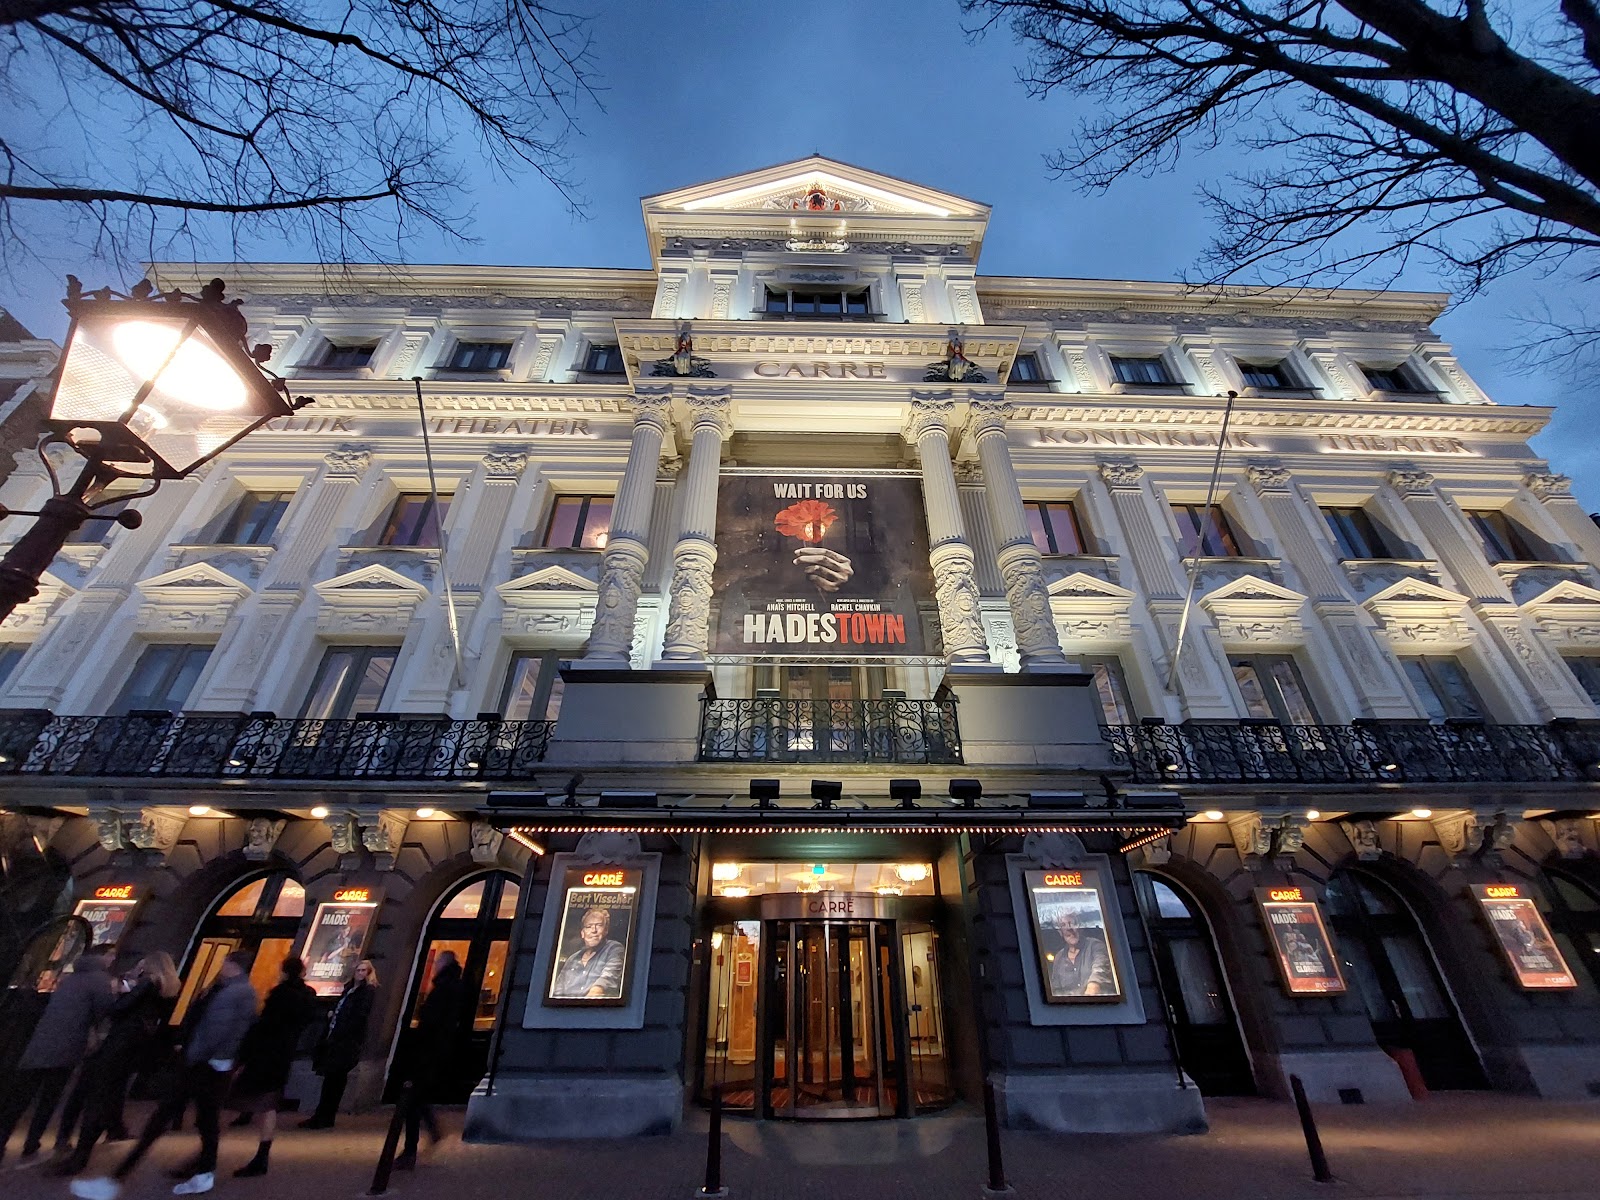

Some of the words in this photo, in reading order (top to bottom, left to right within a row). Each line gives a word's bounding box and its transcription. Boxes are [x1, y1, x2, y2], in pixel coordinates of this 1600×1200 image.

[430, 416, 589, 435] THEATER
[1319, 434, 1472, 453] THEATER
[773, 483, 811, 499] WAIT
[815, 483, 844, 499] FOR
[847, 483, 867, 499] US
[766, 602, 785, 612] ANAÏS
[787, 603, 815, 612] MITCHELL
[830, 602, 853, 612] RACHEL
[743, 613, 906, 644] HADESTOWN
[570, 892, 592, 904] Bert
[593, 893, 633, 905] Visscher
